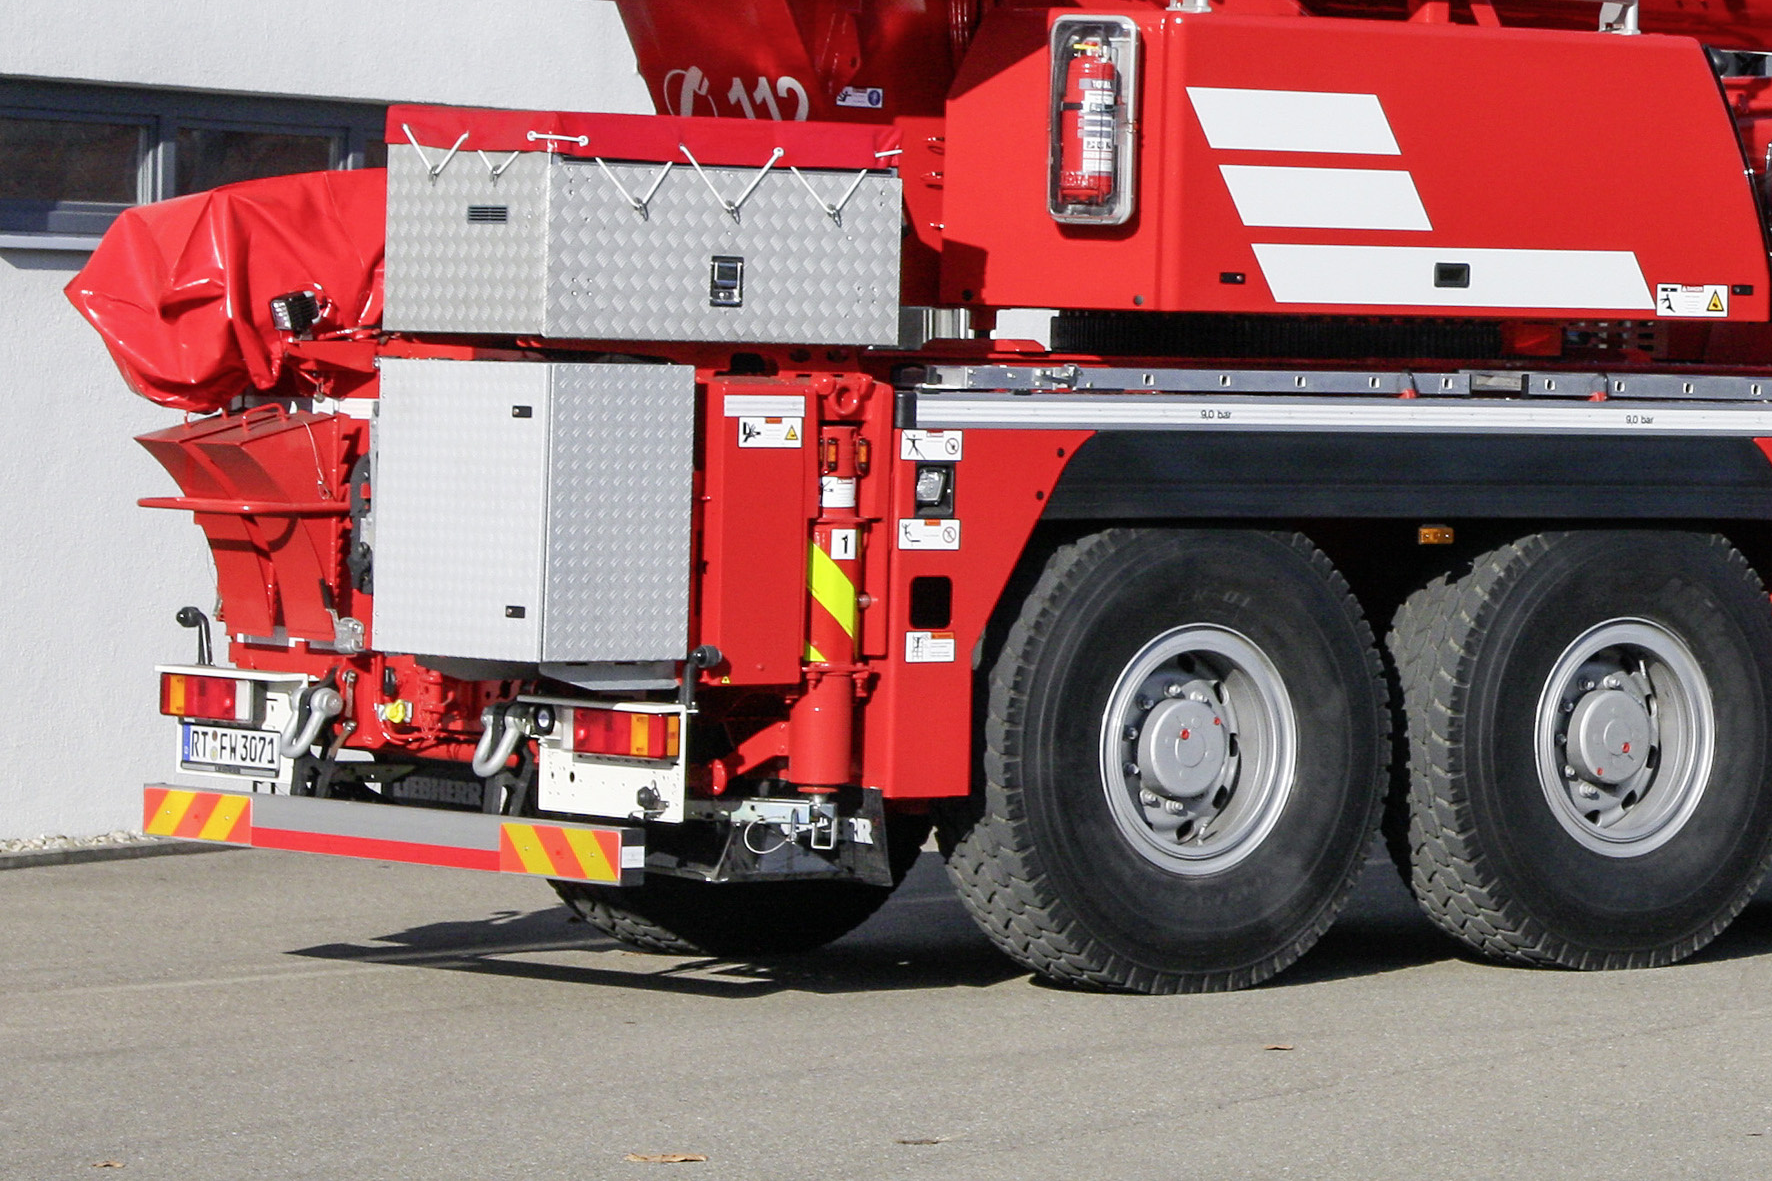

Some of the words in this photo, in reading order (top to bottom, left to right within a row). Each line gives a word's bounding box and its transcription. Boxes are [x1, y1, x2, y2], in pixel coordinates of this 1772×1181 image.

[841, 535, 849, 555] 1
[191, 730, 209, 758] RT
[393, 776, 482, 806] LIEBHERR
